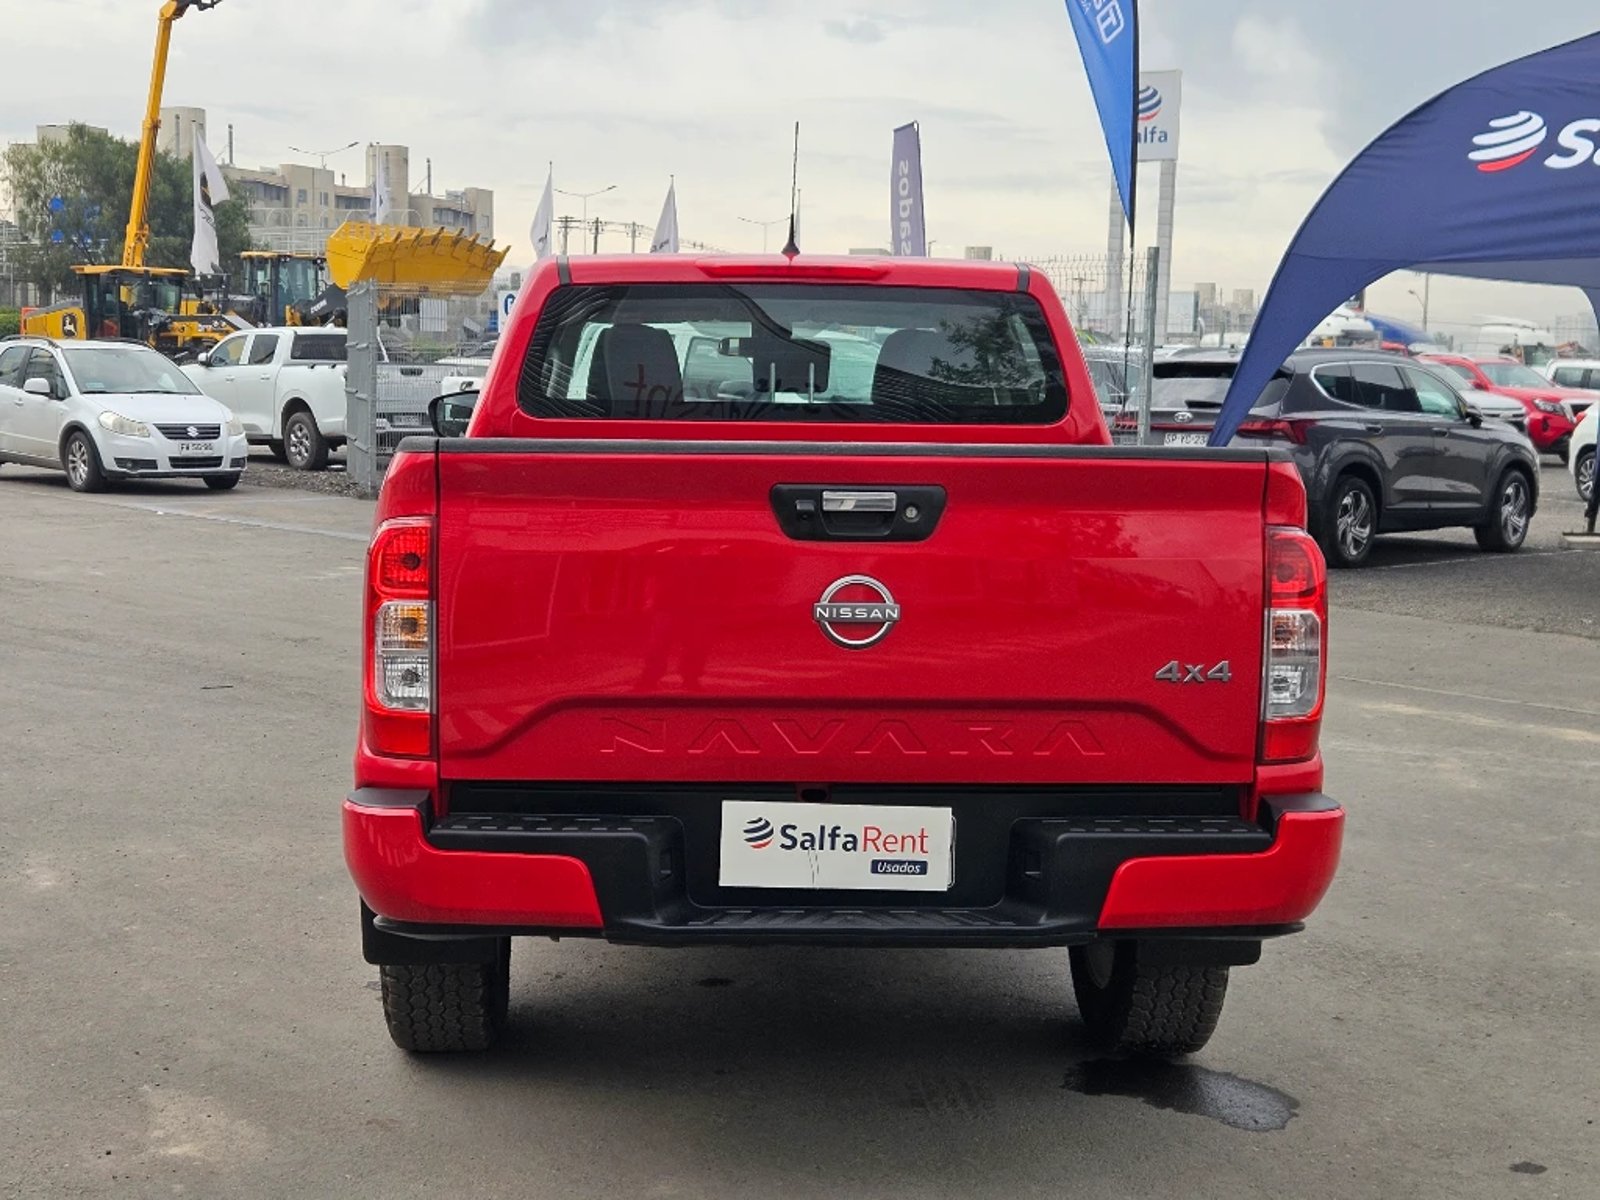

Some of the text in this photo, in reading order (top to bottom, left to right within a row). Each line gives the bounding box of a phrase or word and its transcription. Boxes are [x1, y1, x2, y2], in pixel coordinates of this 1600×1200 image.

[1544, 118, 1600, 169] S
[816, 607, 898, 619] NISSAN
[1155, 660, 1232, 683] 4x4
[600, 717, 1106, 756] NAVARA
[877, 861, 921, 875] Usados
